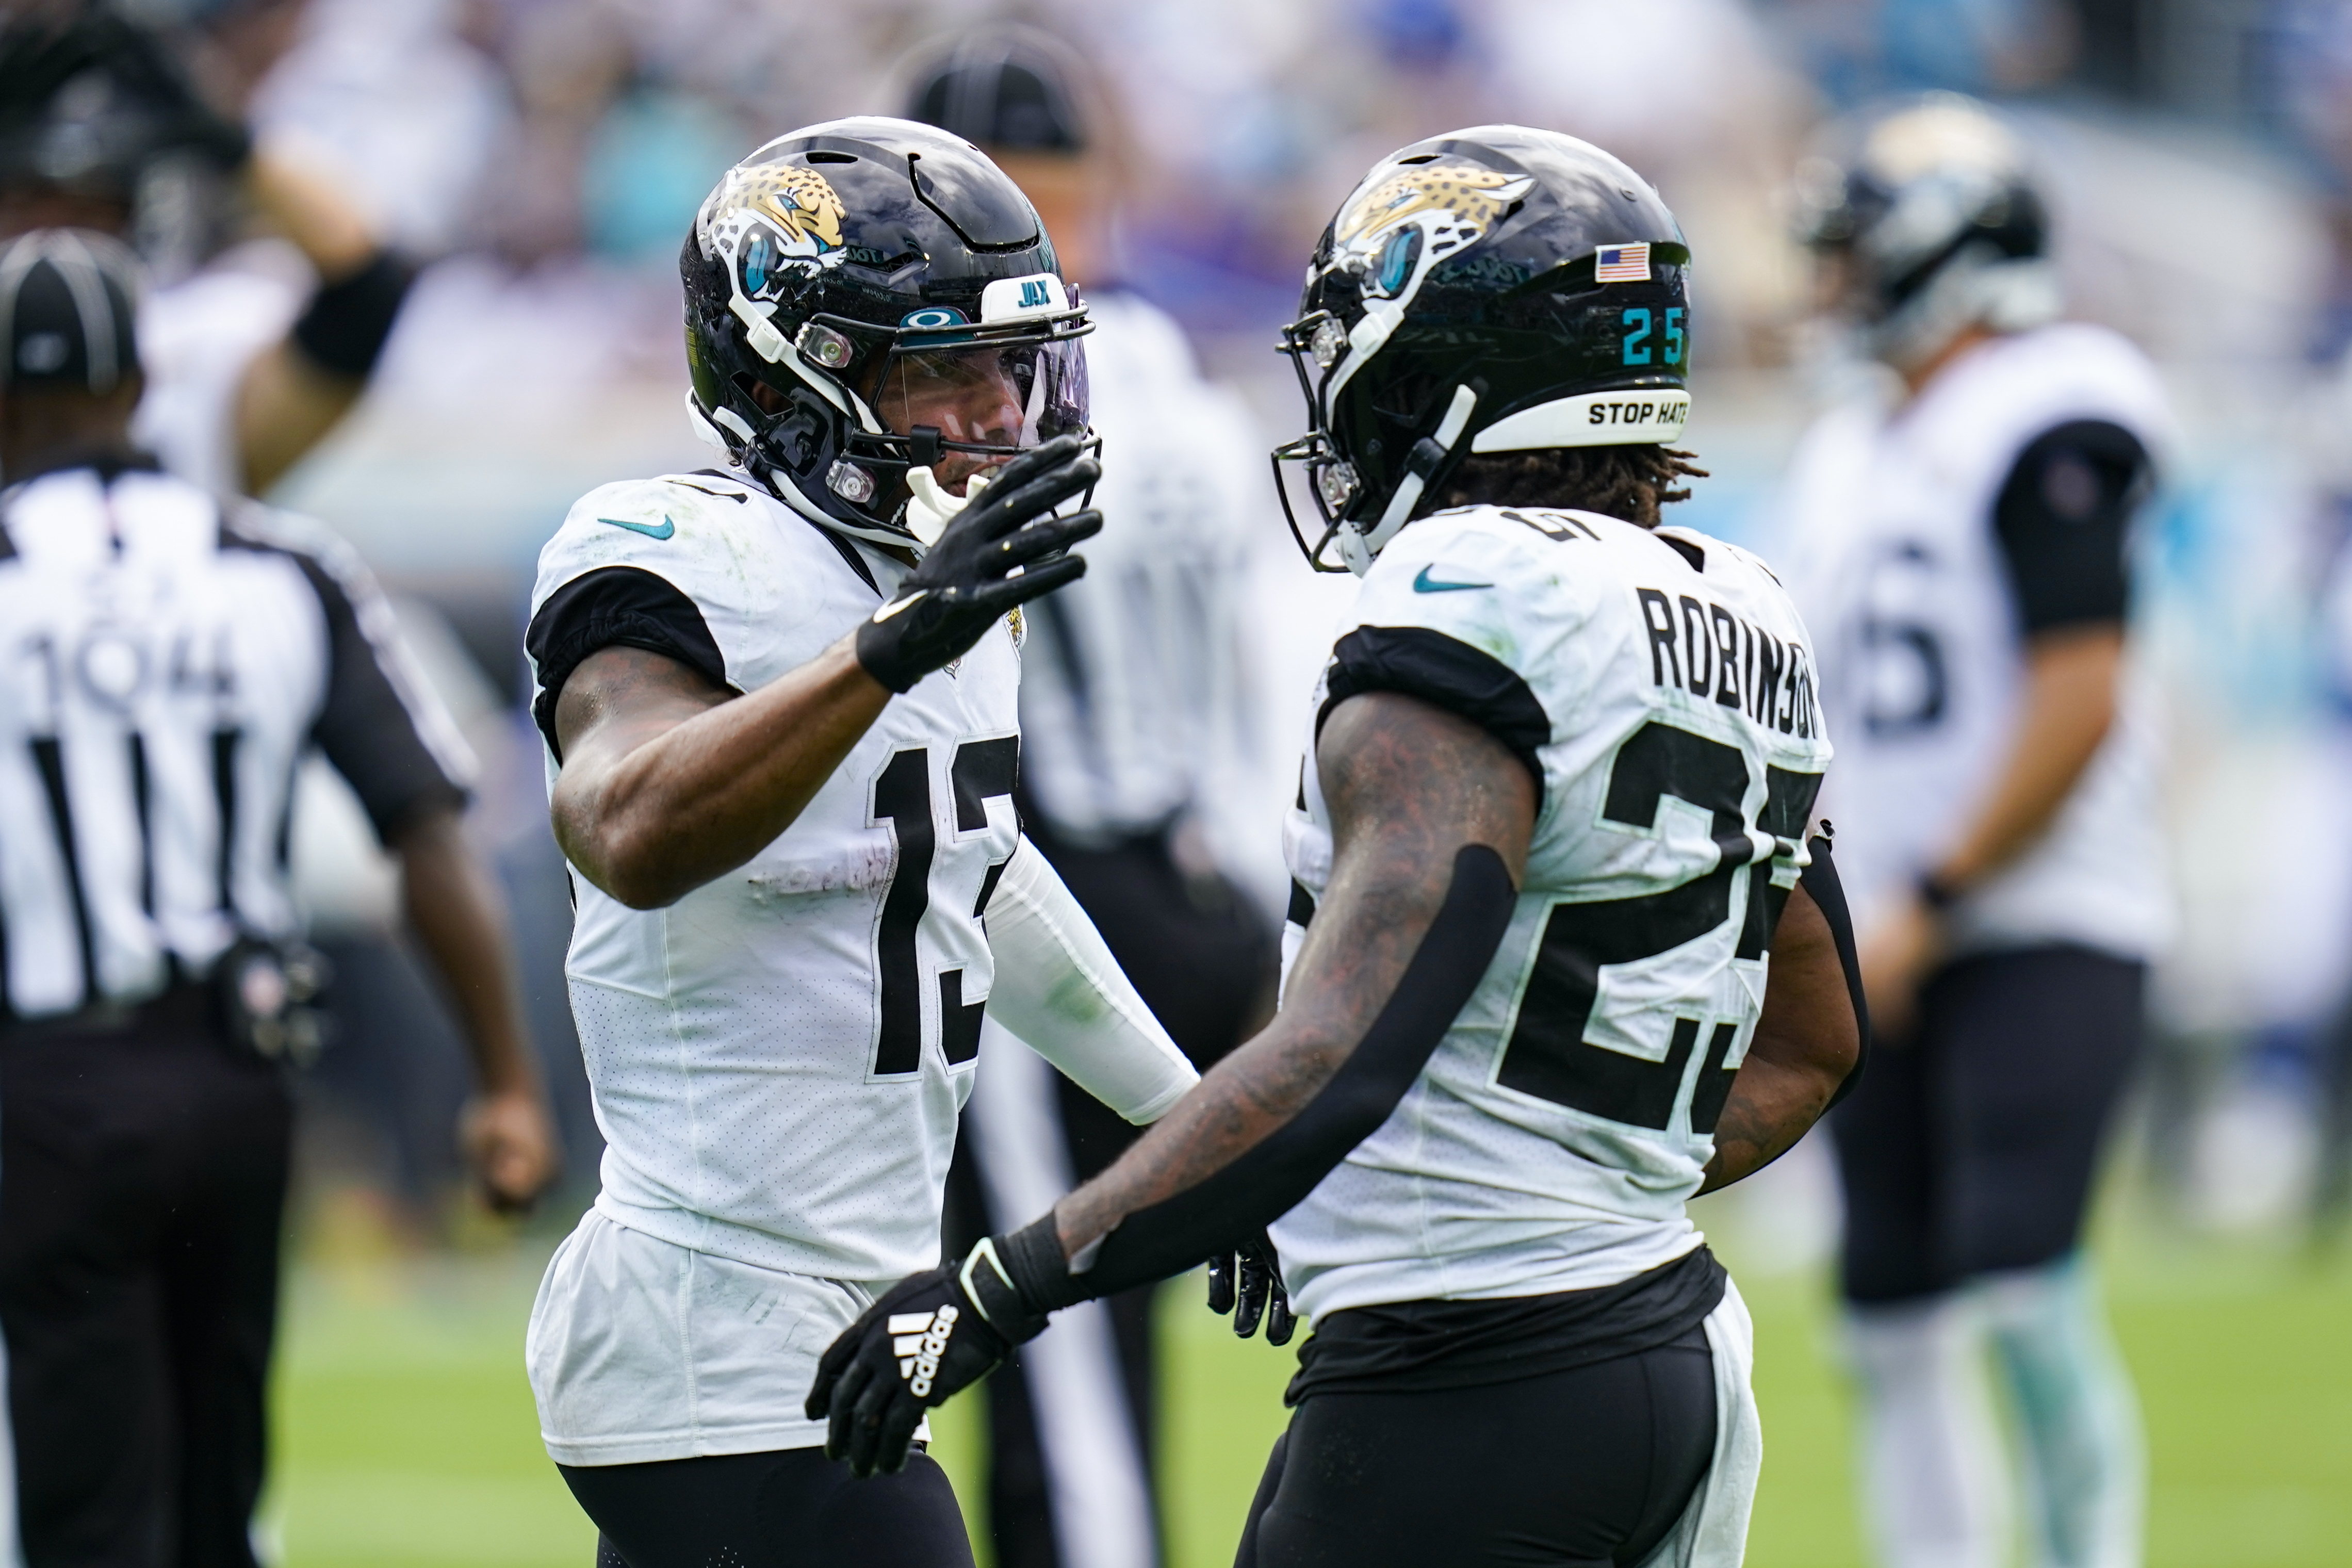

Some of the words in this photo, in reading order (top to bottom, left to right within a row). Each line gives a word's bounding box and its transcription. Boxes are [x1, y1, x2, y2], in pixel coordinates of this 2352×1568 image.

[1018, 280, 1051, 307] JAX
[1623, 307, 1683, 366] 25
[1589, 401, 1654, 424] STOP
[910, 1303, 959, 1397] adidas
